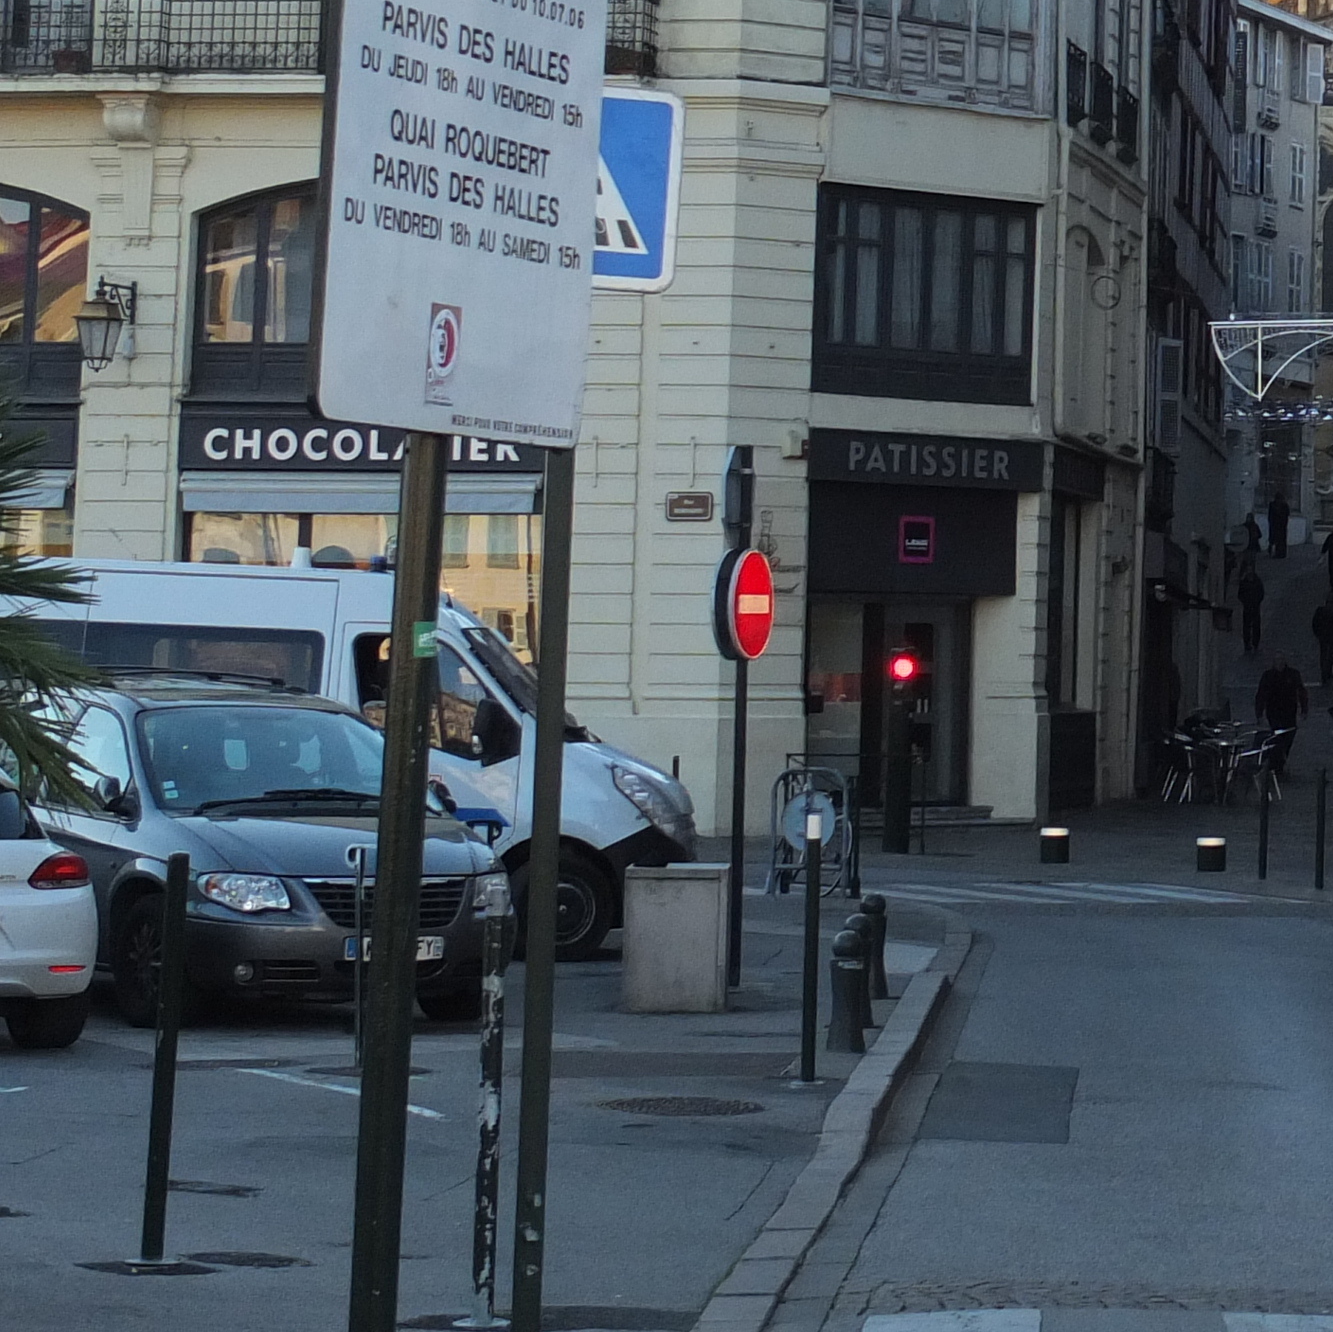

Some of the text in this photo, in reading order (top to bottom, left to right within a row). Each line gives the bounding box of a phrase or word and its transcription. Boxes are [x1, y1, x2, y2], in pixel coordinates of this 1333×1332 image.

[382, 0, 570, 85] PARVIS DES HALLES
[361, 44, 583, 128] DU JEUDI 18h AU VENDREDI 15h
[390, 109, 551, 178] QUAI ROQUEBERT
[373, 153, 560, 227] PARVIS DES HALLES
[344, 197, 581, 269] DU VENDREDI 18h AU SAMEDI 15h
[204, 428, 520, 462] CHOCOLIER
[849, 441, 1010, 480] PATISSIER
